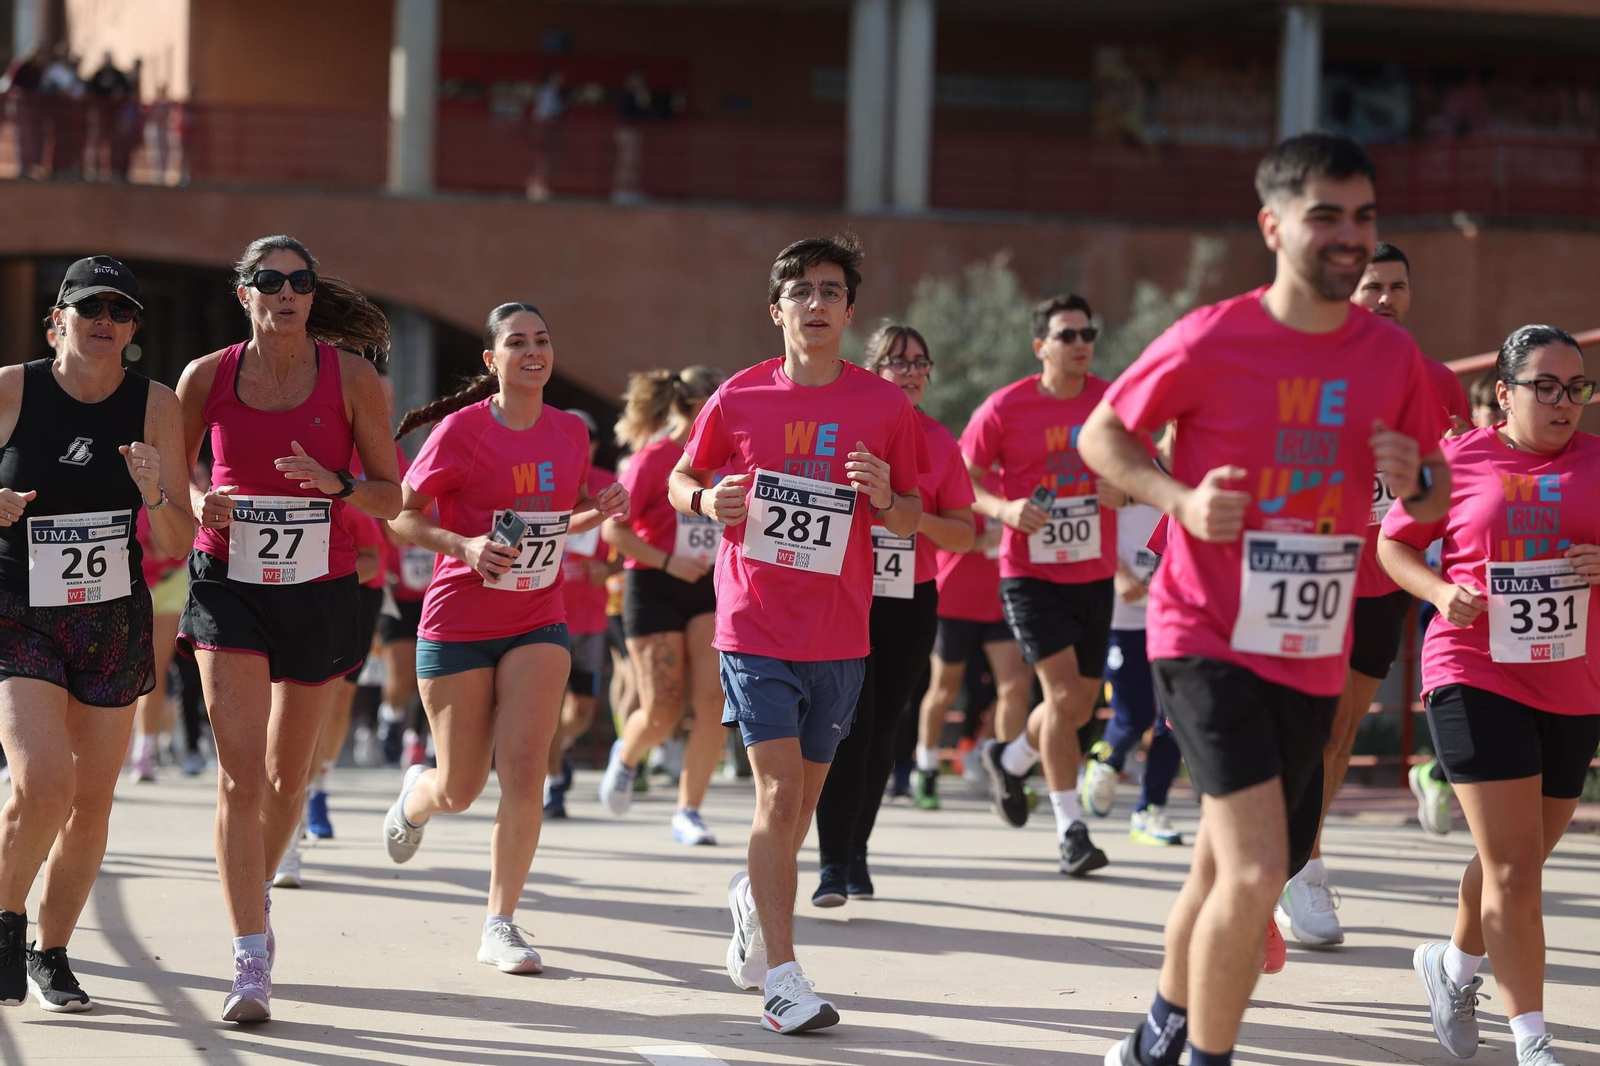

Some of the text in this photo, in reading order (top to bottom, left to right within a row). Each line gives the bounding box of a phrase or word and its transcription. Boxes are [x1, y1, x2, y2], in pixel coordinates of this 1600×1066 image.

[94, 268, 118, 276] SILVER
[1277, 376, 1348, 426] WE
[785, 421, 839, 456] WE
[512, 461, 555, 494] WE
[1502, 474, 1561, 502] WE
[758, 485, 801, 504] UMA
[1258, 468, 1345, 514] UMA
[234, 509, 279, 522] UMA
[763, 506, 832, 547] 281
[1510, 508, 1557, 533] RUN
[34, 529, 82, 542] UMA
[258, 528, 304, 559] 27
[1042, 520, 1090, 544] 300
[62, 546, 107, 579] 26
[778, 552, 794, 561] WE
[1252, 552, 1310, 571] UMA
[264, 571, 280, 580] WE
[1493, 579, 1544, 592] UMA
[68, 591, 85, 600] WE
[1266, 579, 1342, 621] 190
[1510, 595, 1577, 634] 331
[1532, 647, 1550, 657] WE
